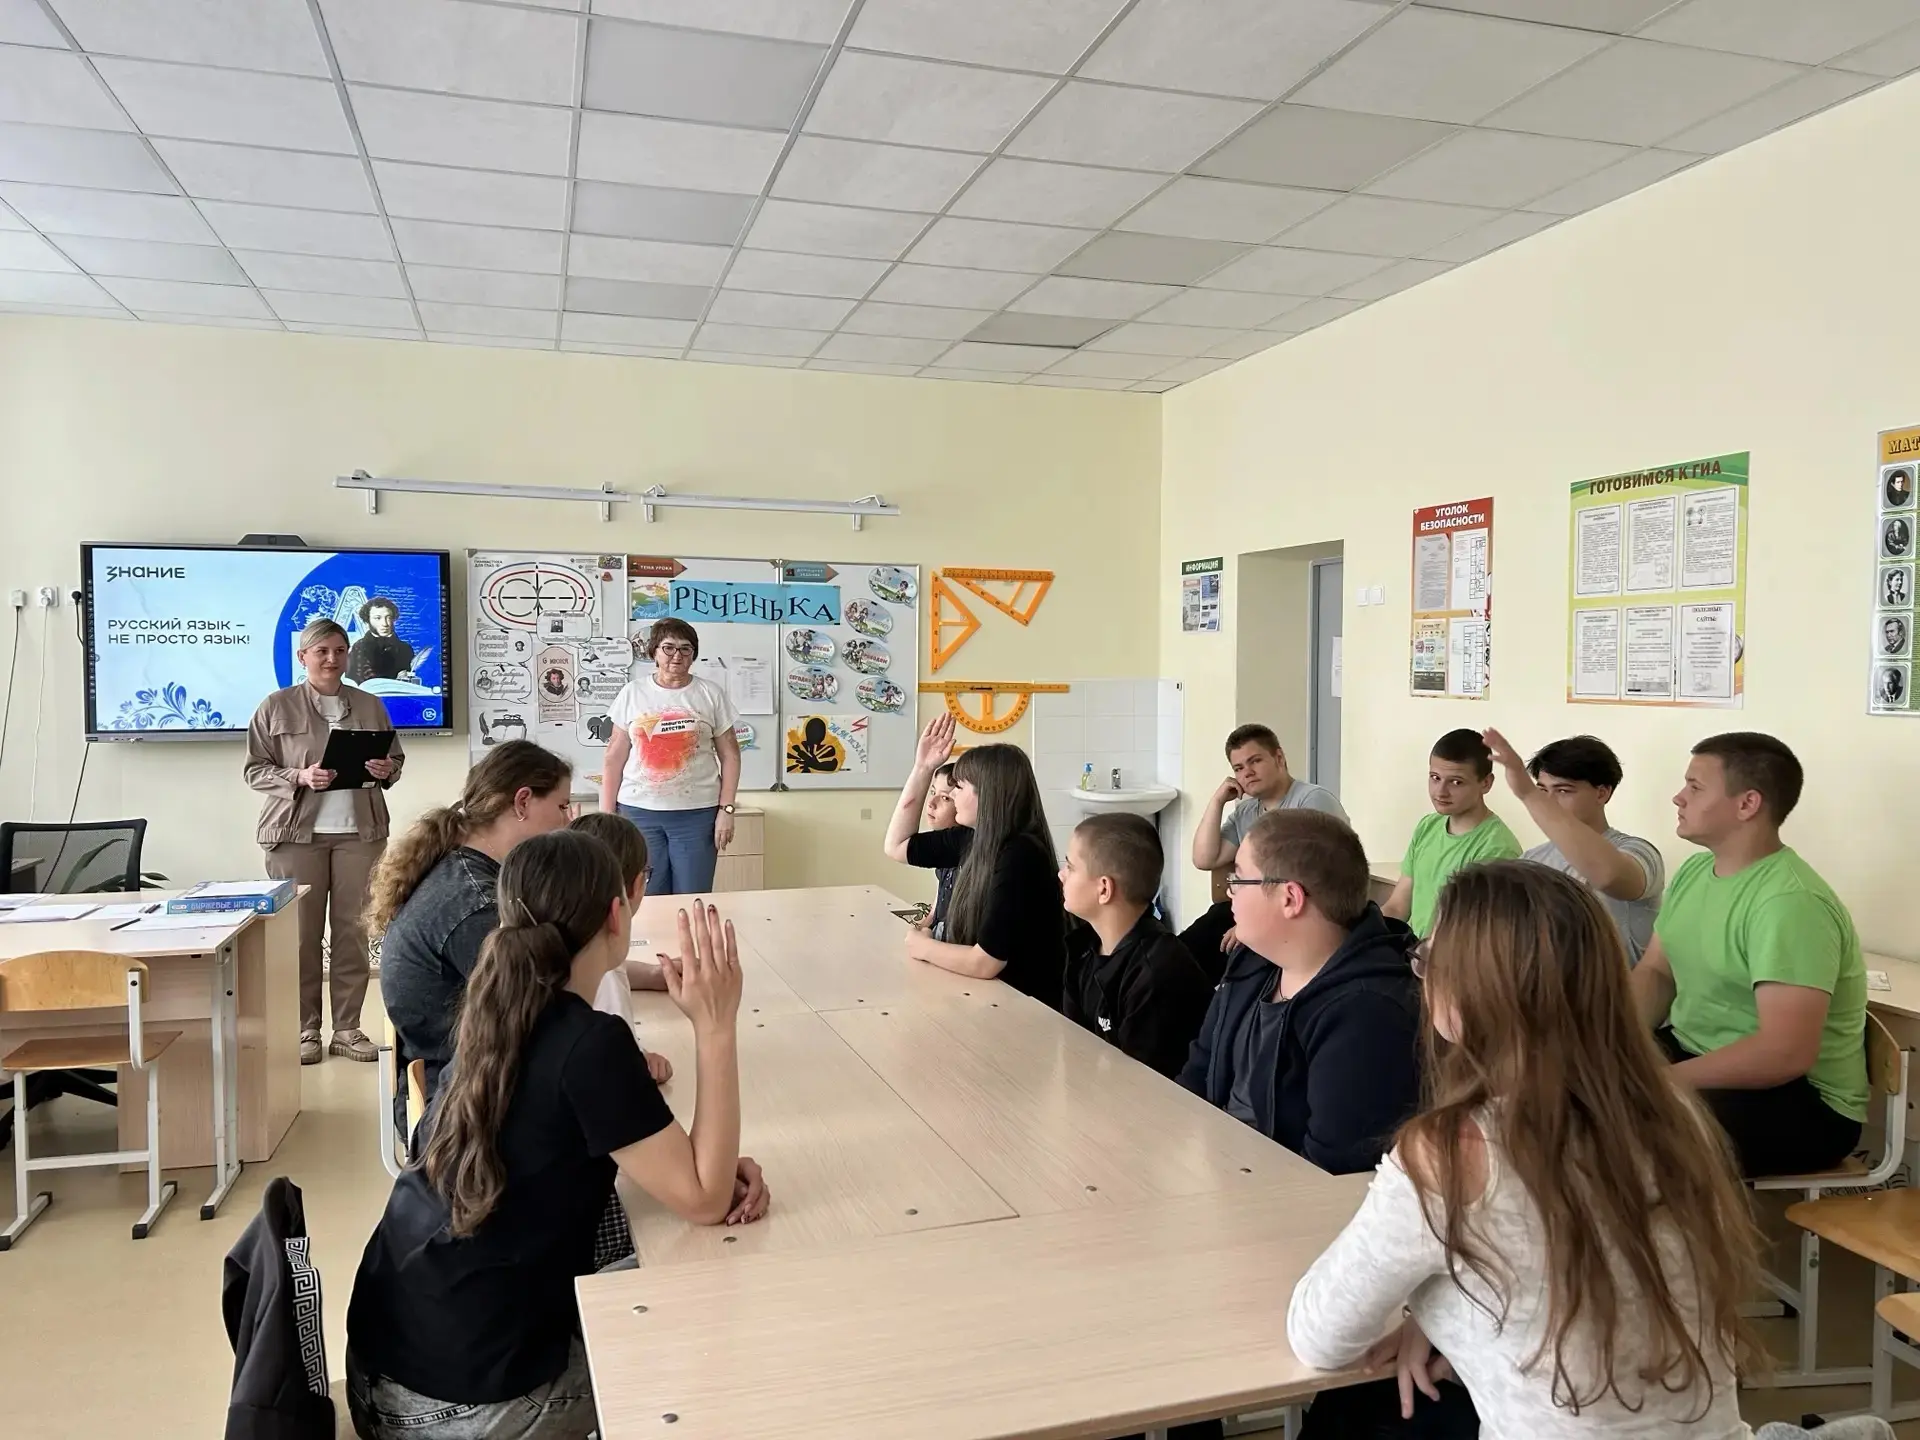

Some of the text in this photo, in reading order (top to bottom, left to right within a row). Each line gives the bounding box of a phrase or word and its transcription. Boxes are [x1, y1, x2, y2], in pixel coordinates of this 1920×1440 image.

[1589, 460, 1721, 495] ГОТОВИМСЯ К ГИА
[1435, 503, 1469, 517] УГОЛОК
[1420, 513, 1485, 531] БЕЗОПАСНОСТИ
[674, 586, 837, 622] РЕЧЕНЬКА
[108, 618, 181, 630] РУССКИЙ
[187, 620, 231, 631] ЯЗЫК
[108, 634, 251, 645] НЕ ПРОСТО ЯЗЫК!
[588, 725, 600, 739] Я
